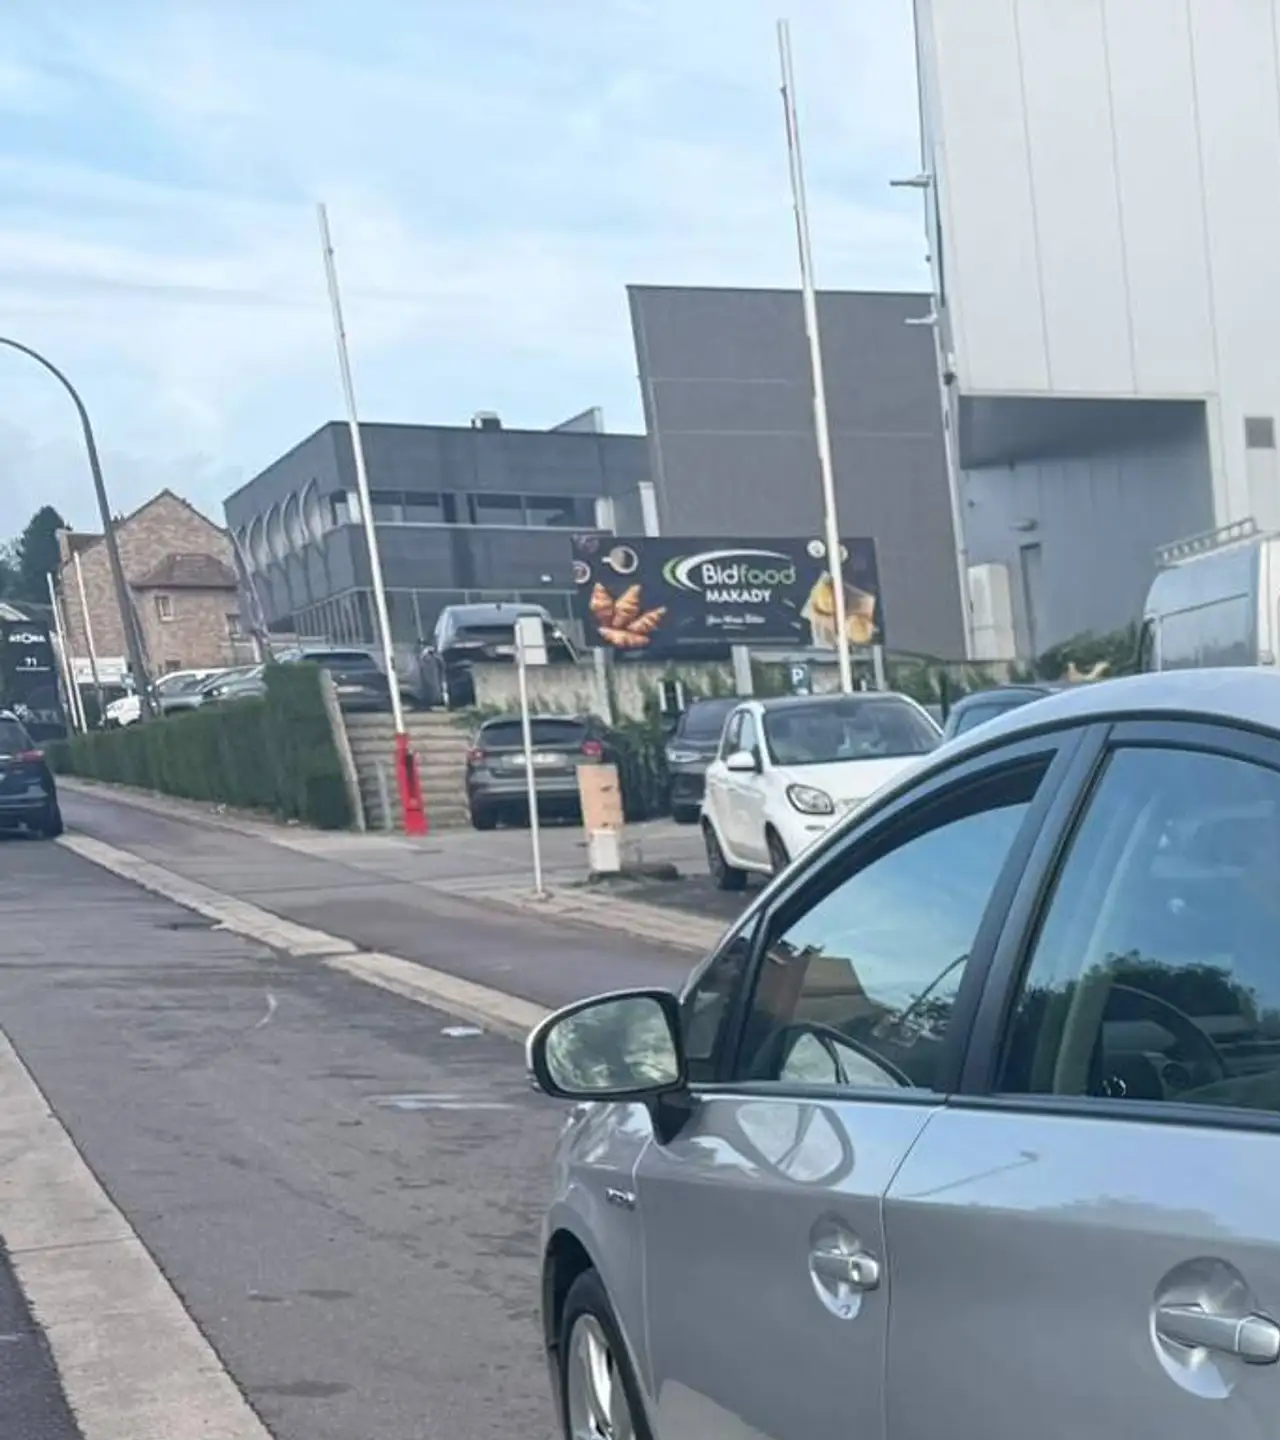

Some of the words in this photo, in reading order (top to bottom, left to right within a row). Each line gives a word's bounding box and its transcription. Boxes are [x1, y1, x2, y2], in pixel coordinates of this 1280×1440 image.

[701, 562, 797, 586] Bidfood
[705, 588, 773, 604] MAKADY
[791, 667, 805, 686] P
